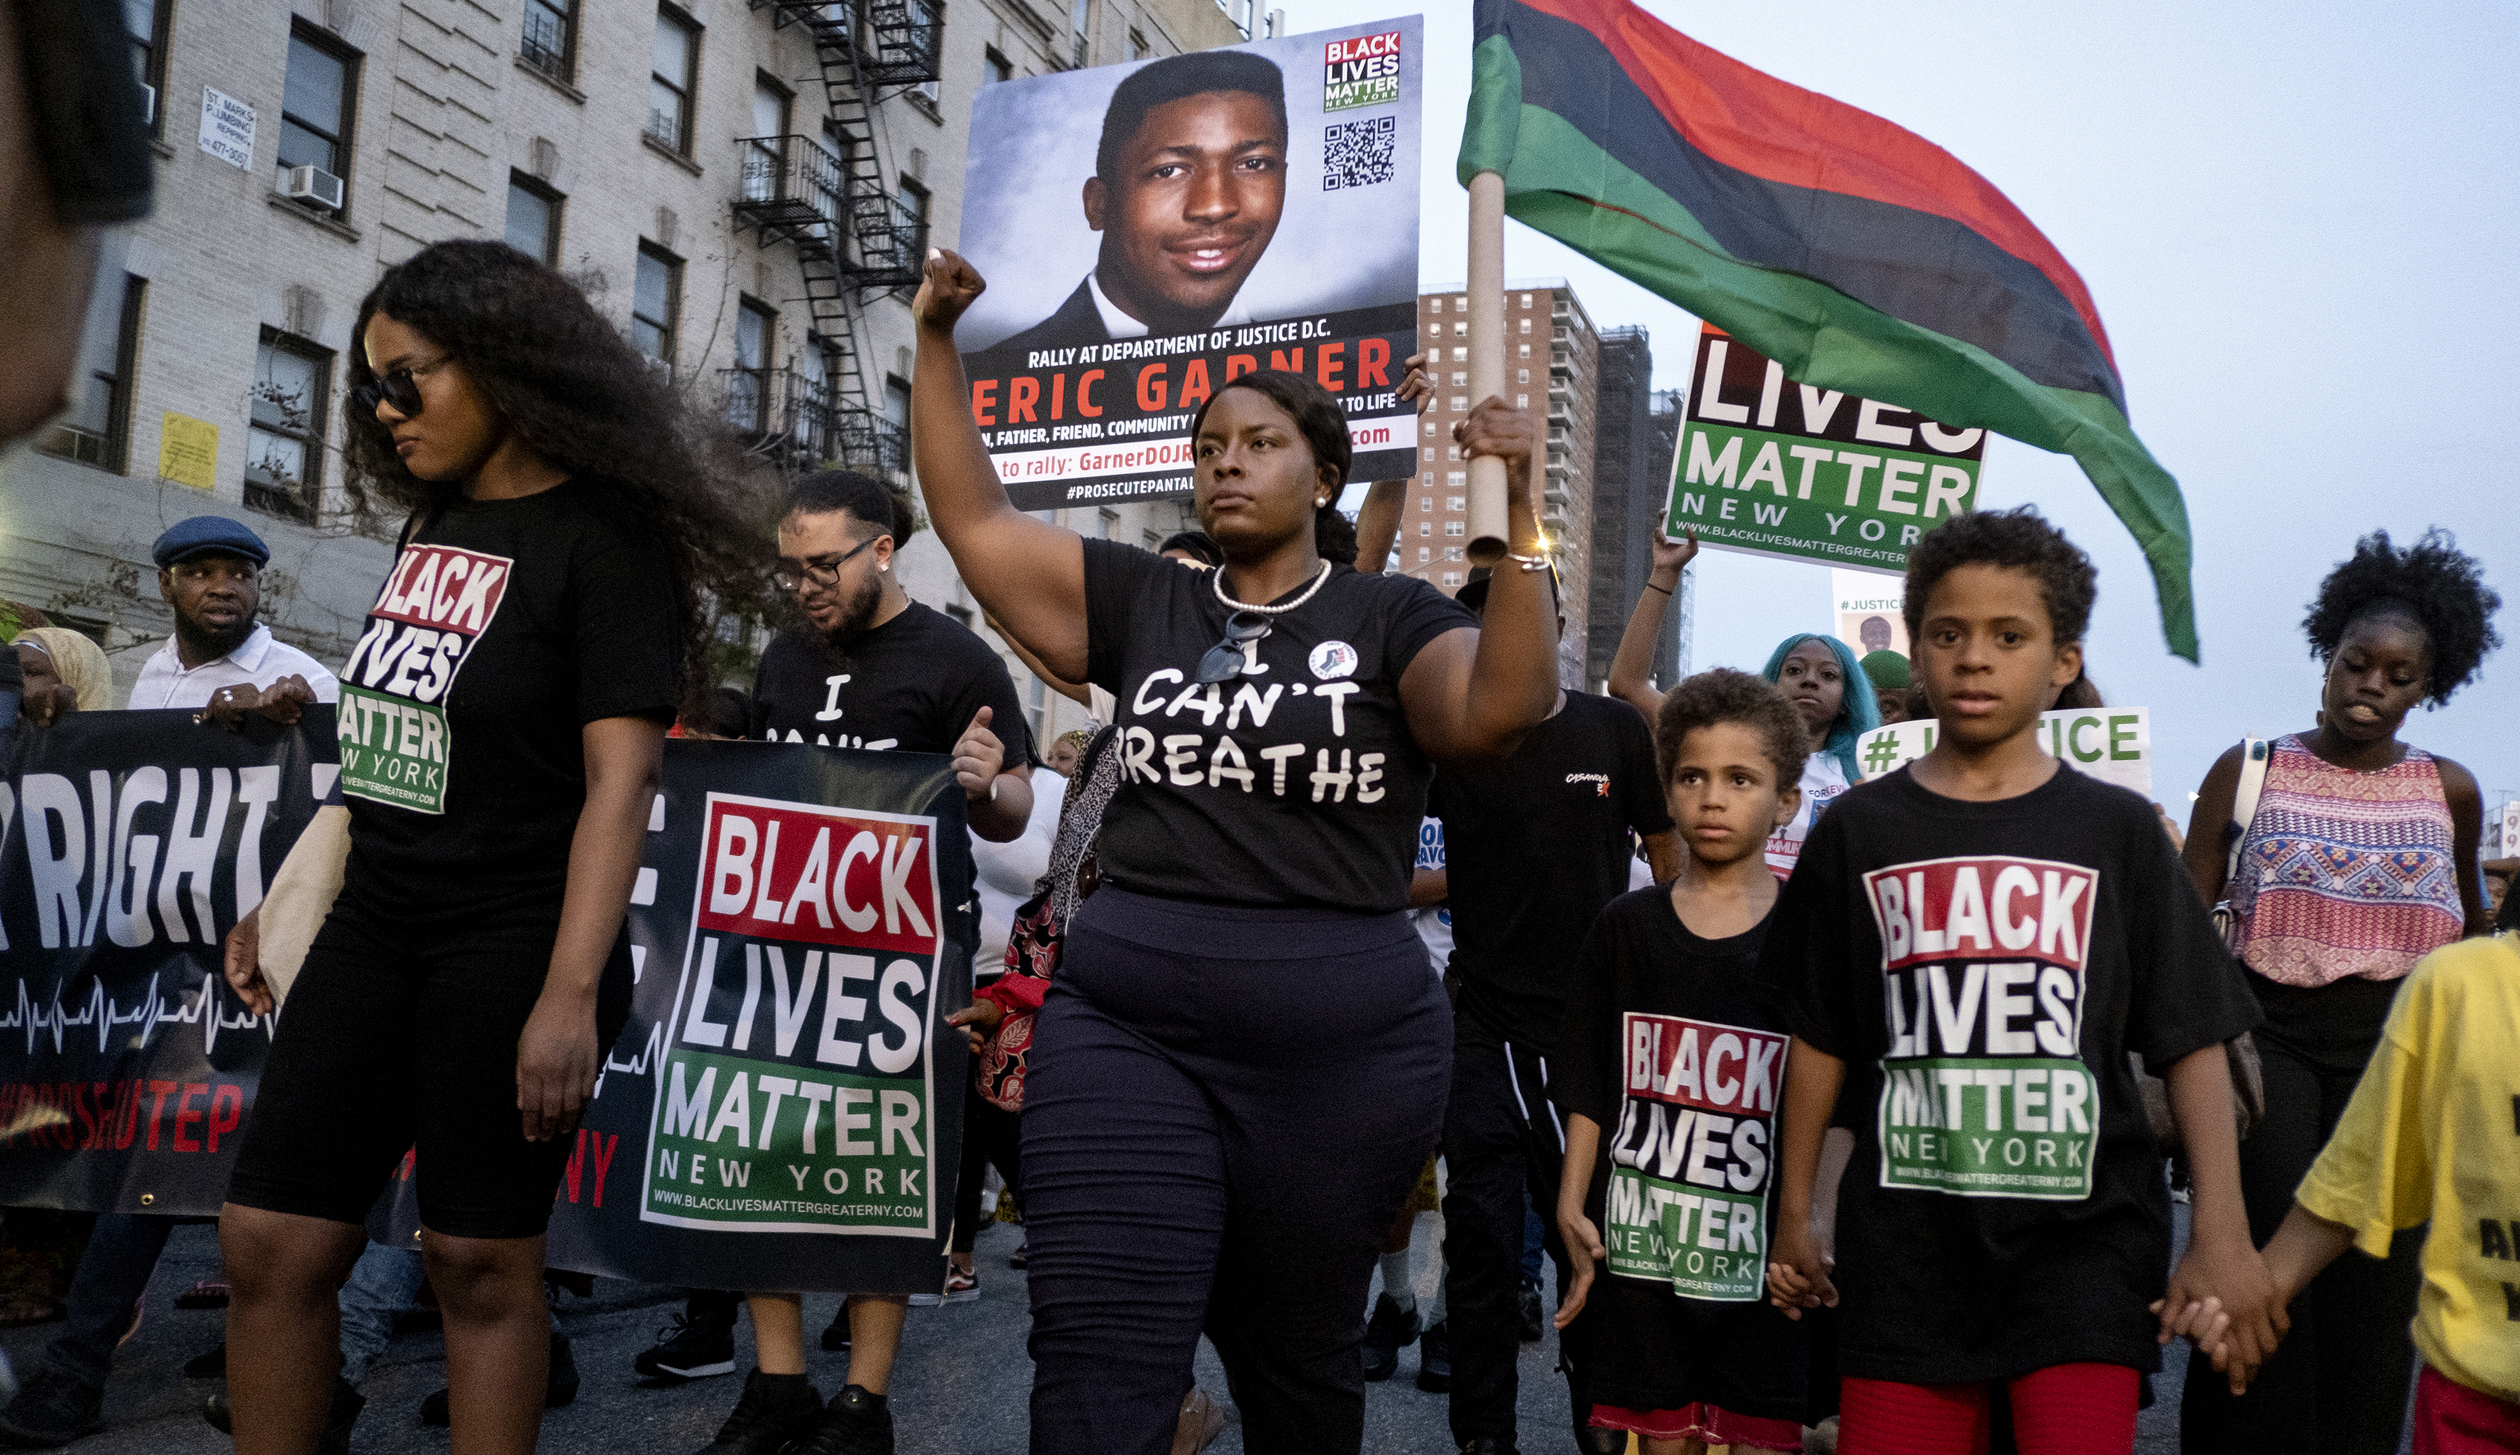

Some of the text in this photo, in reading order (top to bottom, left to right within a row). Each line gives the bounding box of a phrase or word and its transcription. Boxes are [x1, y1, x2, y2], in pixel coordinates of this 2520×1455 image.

[1326, 54, 1399, 85] LIVES
[1327, 32, 1399, 63] BLACK
[1325, 75, 1399, 101] MATTER
[1325, 97, 1354, 108] NEW
[1362, 89, 1398, 102] YORK
[1028, 318, 1331, 369] RALLY AT DEPARTMENT OF JUSTICE D.C.
[971, 368, 1105, 427] ERIC
[997, 427, 1050, 446] FATHER,
[1053, 423, 1105, 442] FRIEND,
[1107, 414, 1190, 437] COMMUNITY
[1346, 395, 1365, 413] TO
[1367, 392, 1397, 411] LIFE
[1002, 460, 1020, 478] to
[1026, 455, 1073, 476] rally:
[1685, 430, 1972, 519] MATTER
[1675, 519, 1908, 565] WWW.BLACKLIVESMATTERGREATER
[1681, 491, 1922, 546] NEW YOR
[374, 550, 506, 632] LACK
[340, 617, 464, 704] IVES
[815, 673, 852, 721] I
[1132, 667, 1361, 738] CAN'T
[337, 692, 444, 764] ATTER
[373, 753, 440, 791] YORK
[22, 764, 281, 949] RIGHT
[708, 813, 935, 938] BLACK
[1876, 865, 2090, 962] BLACK
[681, 935, 926, 1074] LIVES
[1888, 962, 2076, 1058] LIVES
[1630, 1020, 1782, 1113] BLACK
[663, 1061, 926, 1158] MATTER
[659, 1148, 922, 1197] NEW YORK
[1614, 1099, 1768, 1193] LIVES
[1890, 1132, 2085, 1168] NE YORK
[654, 1188, 924, 1219] WWW.BLACKLIVESMATTERGREATERNY.COM
[1610, 1228, 1754, 1280] NEW YORK
